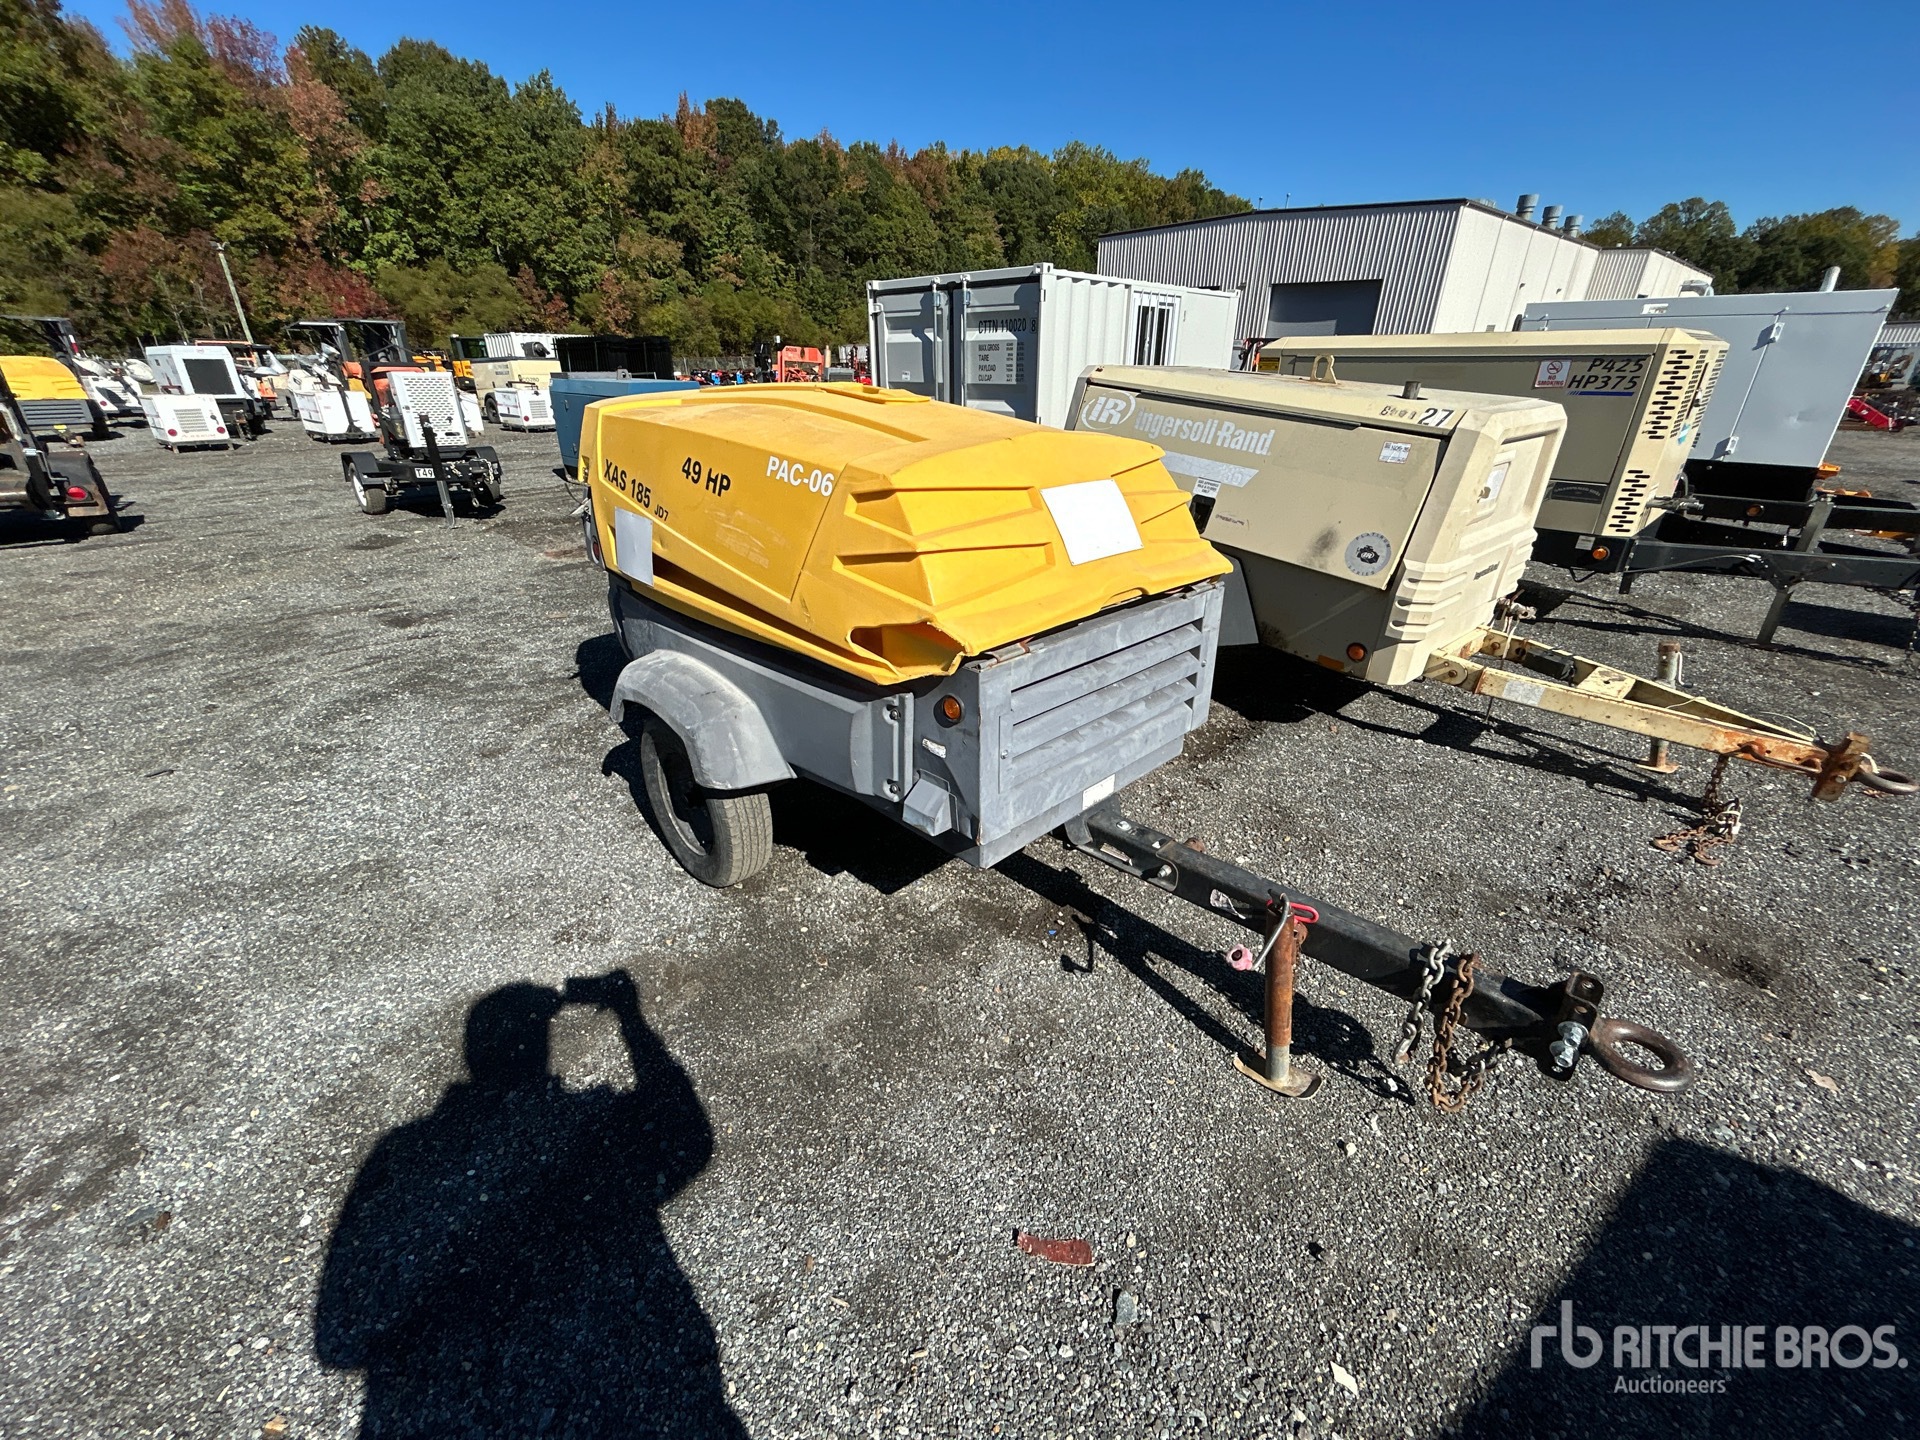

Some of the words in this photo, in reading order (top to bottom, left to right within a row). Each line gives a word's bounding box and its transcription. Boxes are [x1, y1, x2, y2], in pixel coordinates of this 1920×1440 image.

[978, 320, 998, 334] CTTN
[1001, 318, 1027, 332] 110020
[1587, 358, 1646, 373] P425
[1567, 375, 1641, 390] HP375
[1089, 396, 1127, 425] IR
[1417, 408, 1455, 427] 27
[682, 456, 702, 484] 49
[705, 468, 731, 497] HP
[766, 455, 835, 497] PAC-06
[604, 459, 627, 491] XAS
[630, 479, 651, 508] 185
[654, 503, 669, 522] JD7
